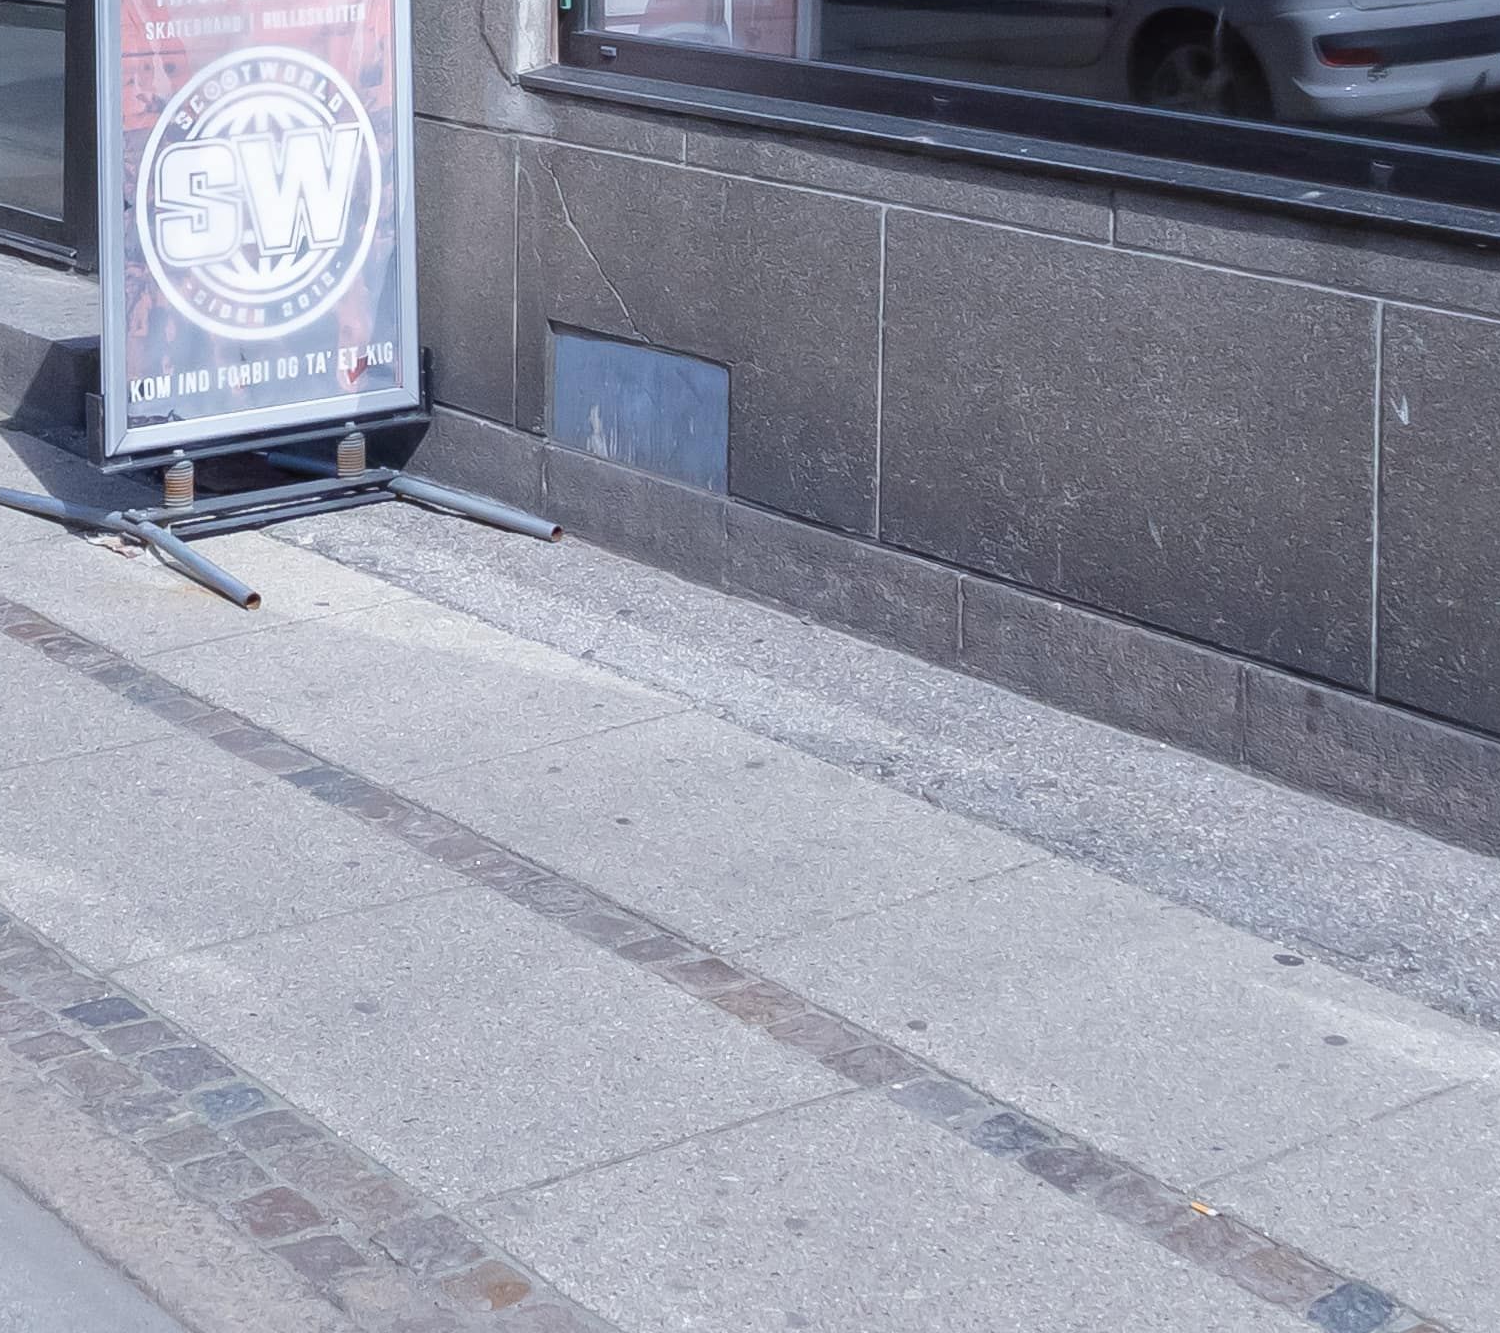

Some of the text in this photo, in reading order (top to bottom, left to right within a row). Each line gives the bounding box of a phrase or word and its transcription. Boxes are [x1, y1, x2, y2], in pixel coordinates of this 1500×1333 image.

[174, 60, 344, 131] SCOOTWORLD
[155, 123, 361, 268] SW
[130, 341, 394, 404] KOM IND FORBI OG TA' ET KIG
